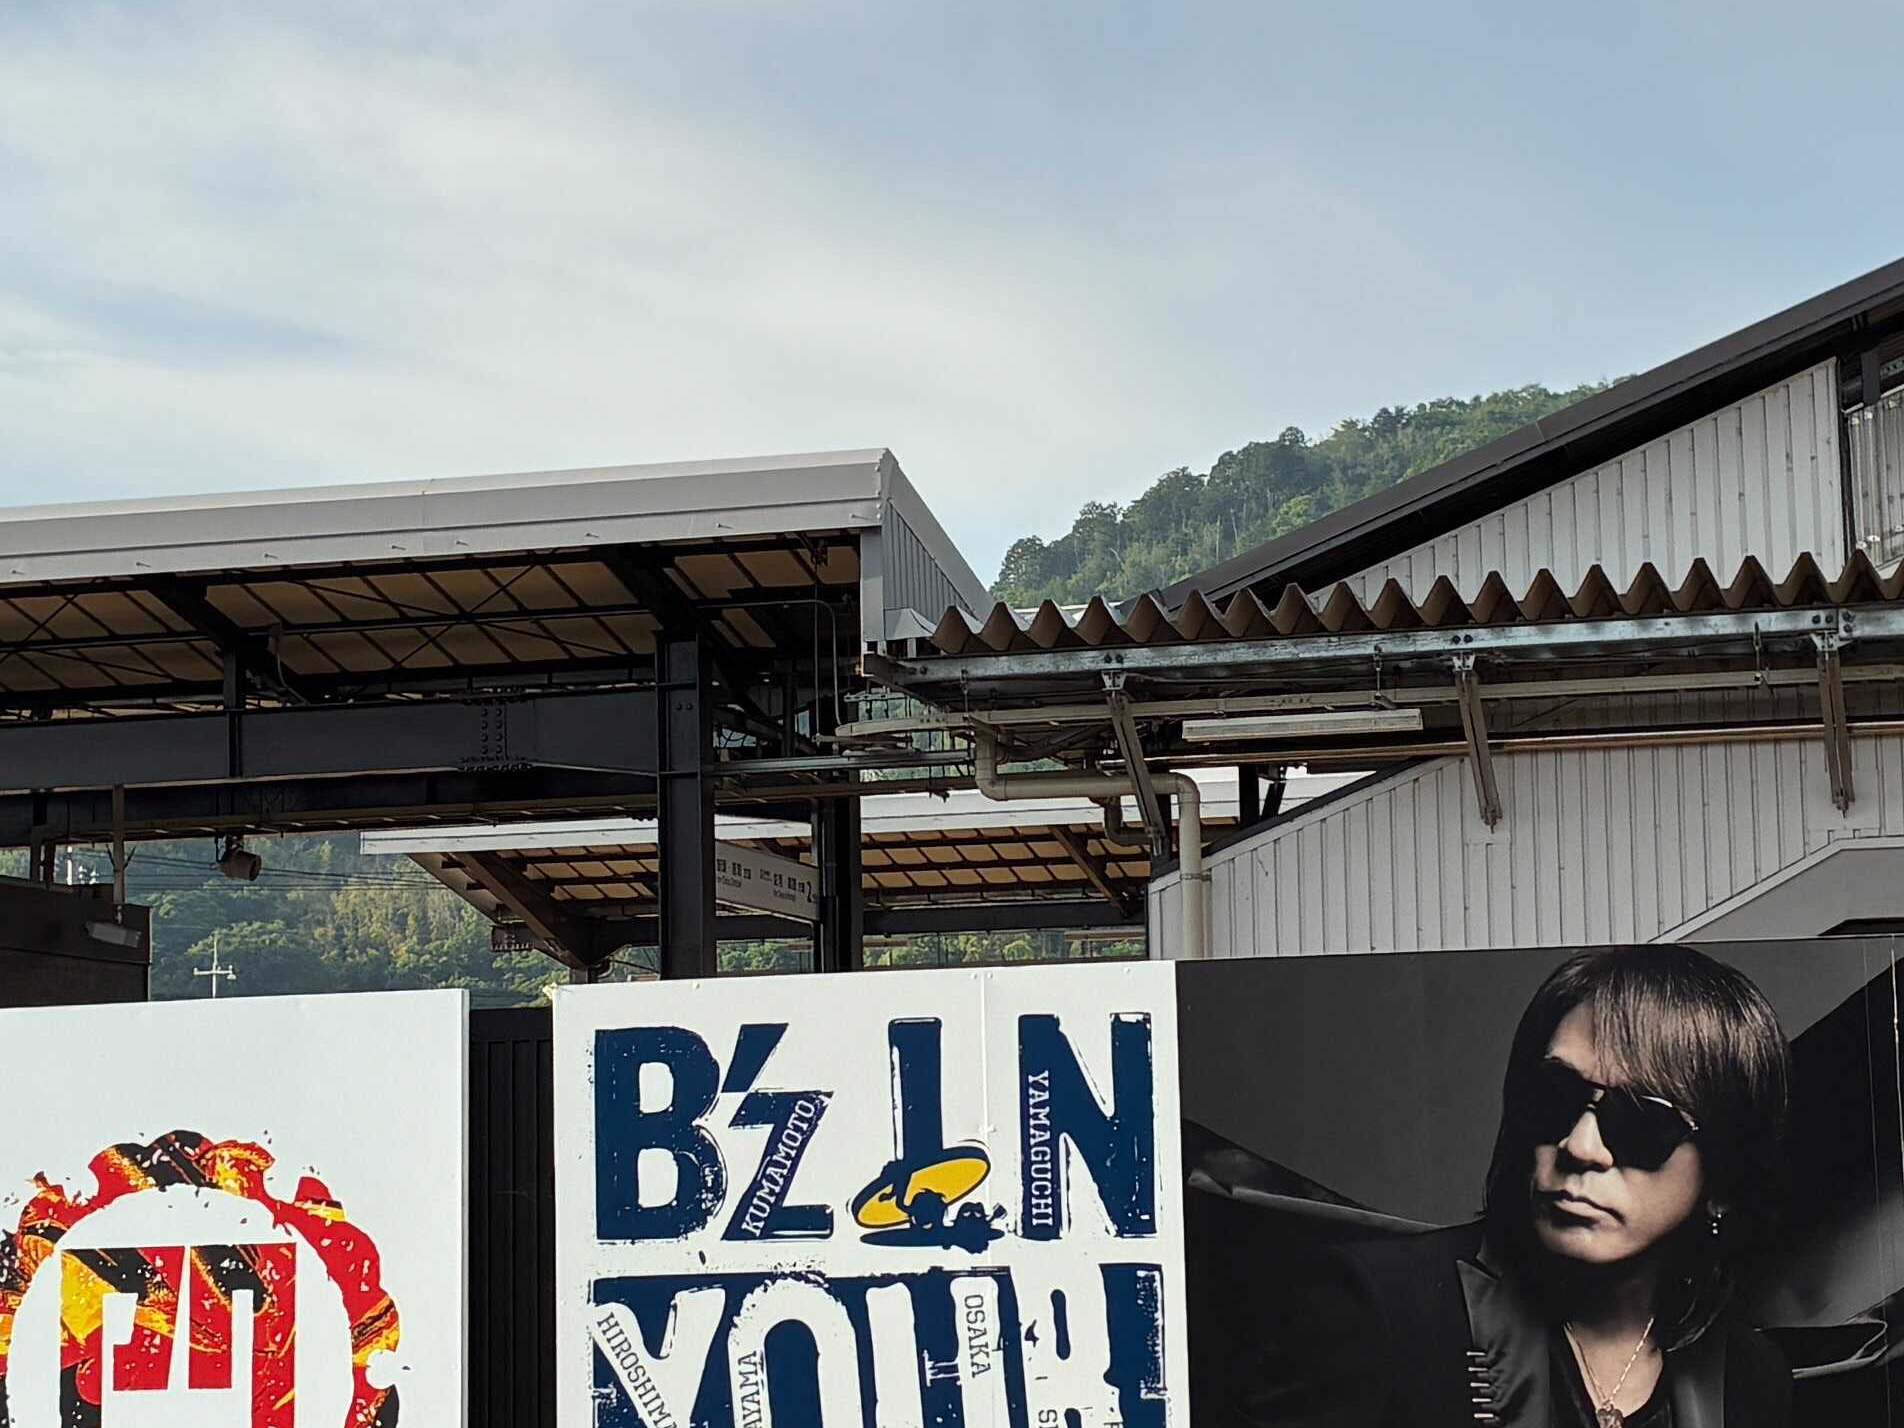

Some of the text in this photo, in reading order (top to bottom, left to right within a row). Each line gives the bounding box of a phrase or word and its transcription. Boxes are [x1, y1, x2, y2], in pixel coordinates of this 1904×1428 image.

[741, 1097, 817, 1238] KUMAMOTO
[1027, 1070, 1054, 1228] YAMAGUCHI
[963, 1293, 993, 1379] OSAKA
